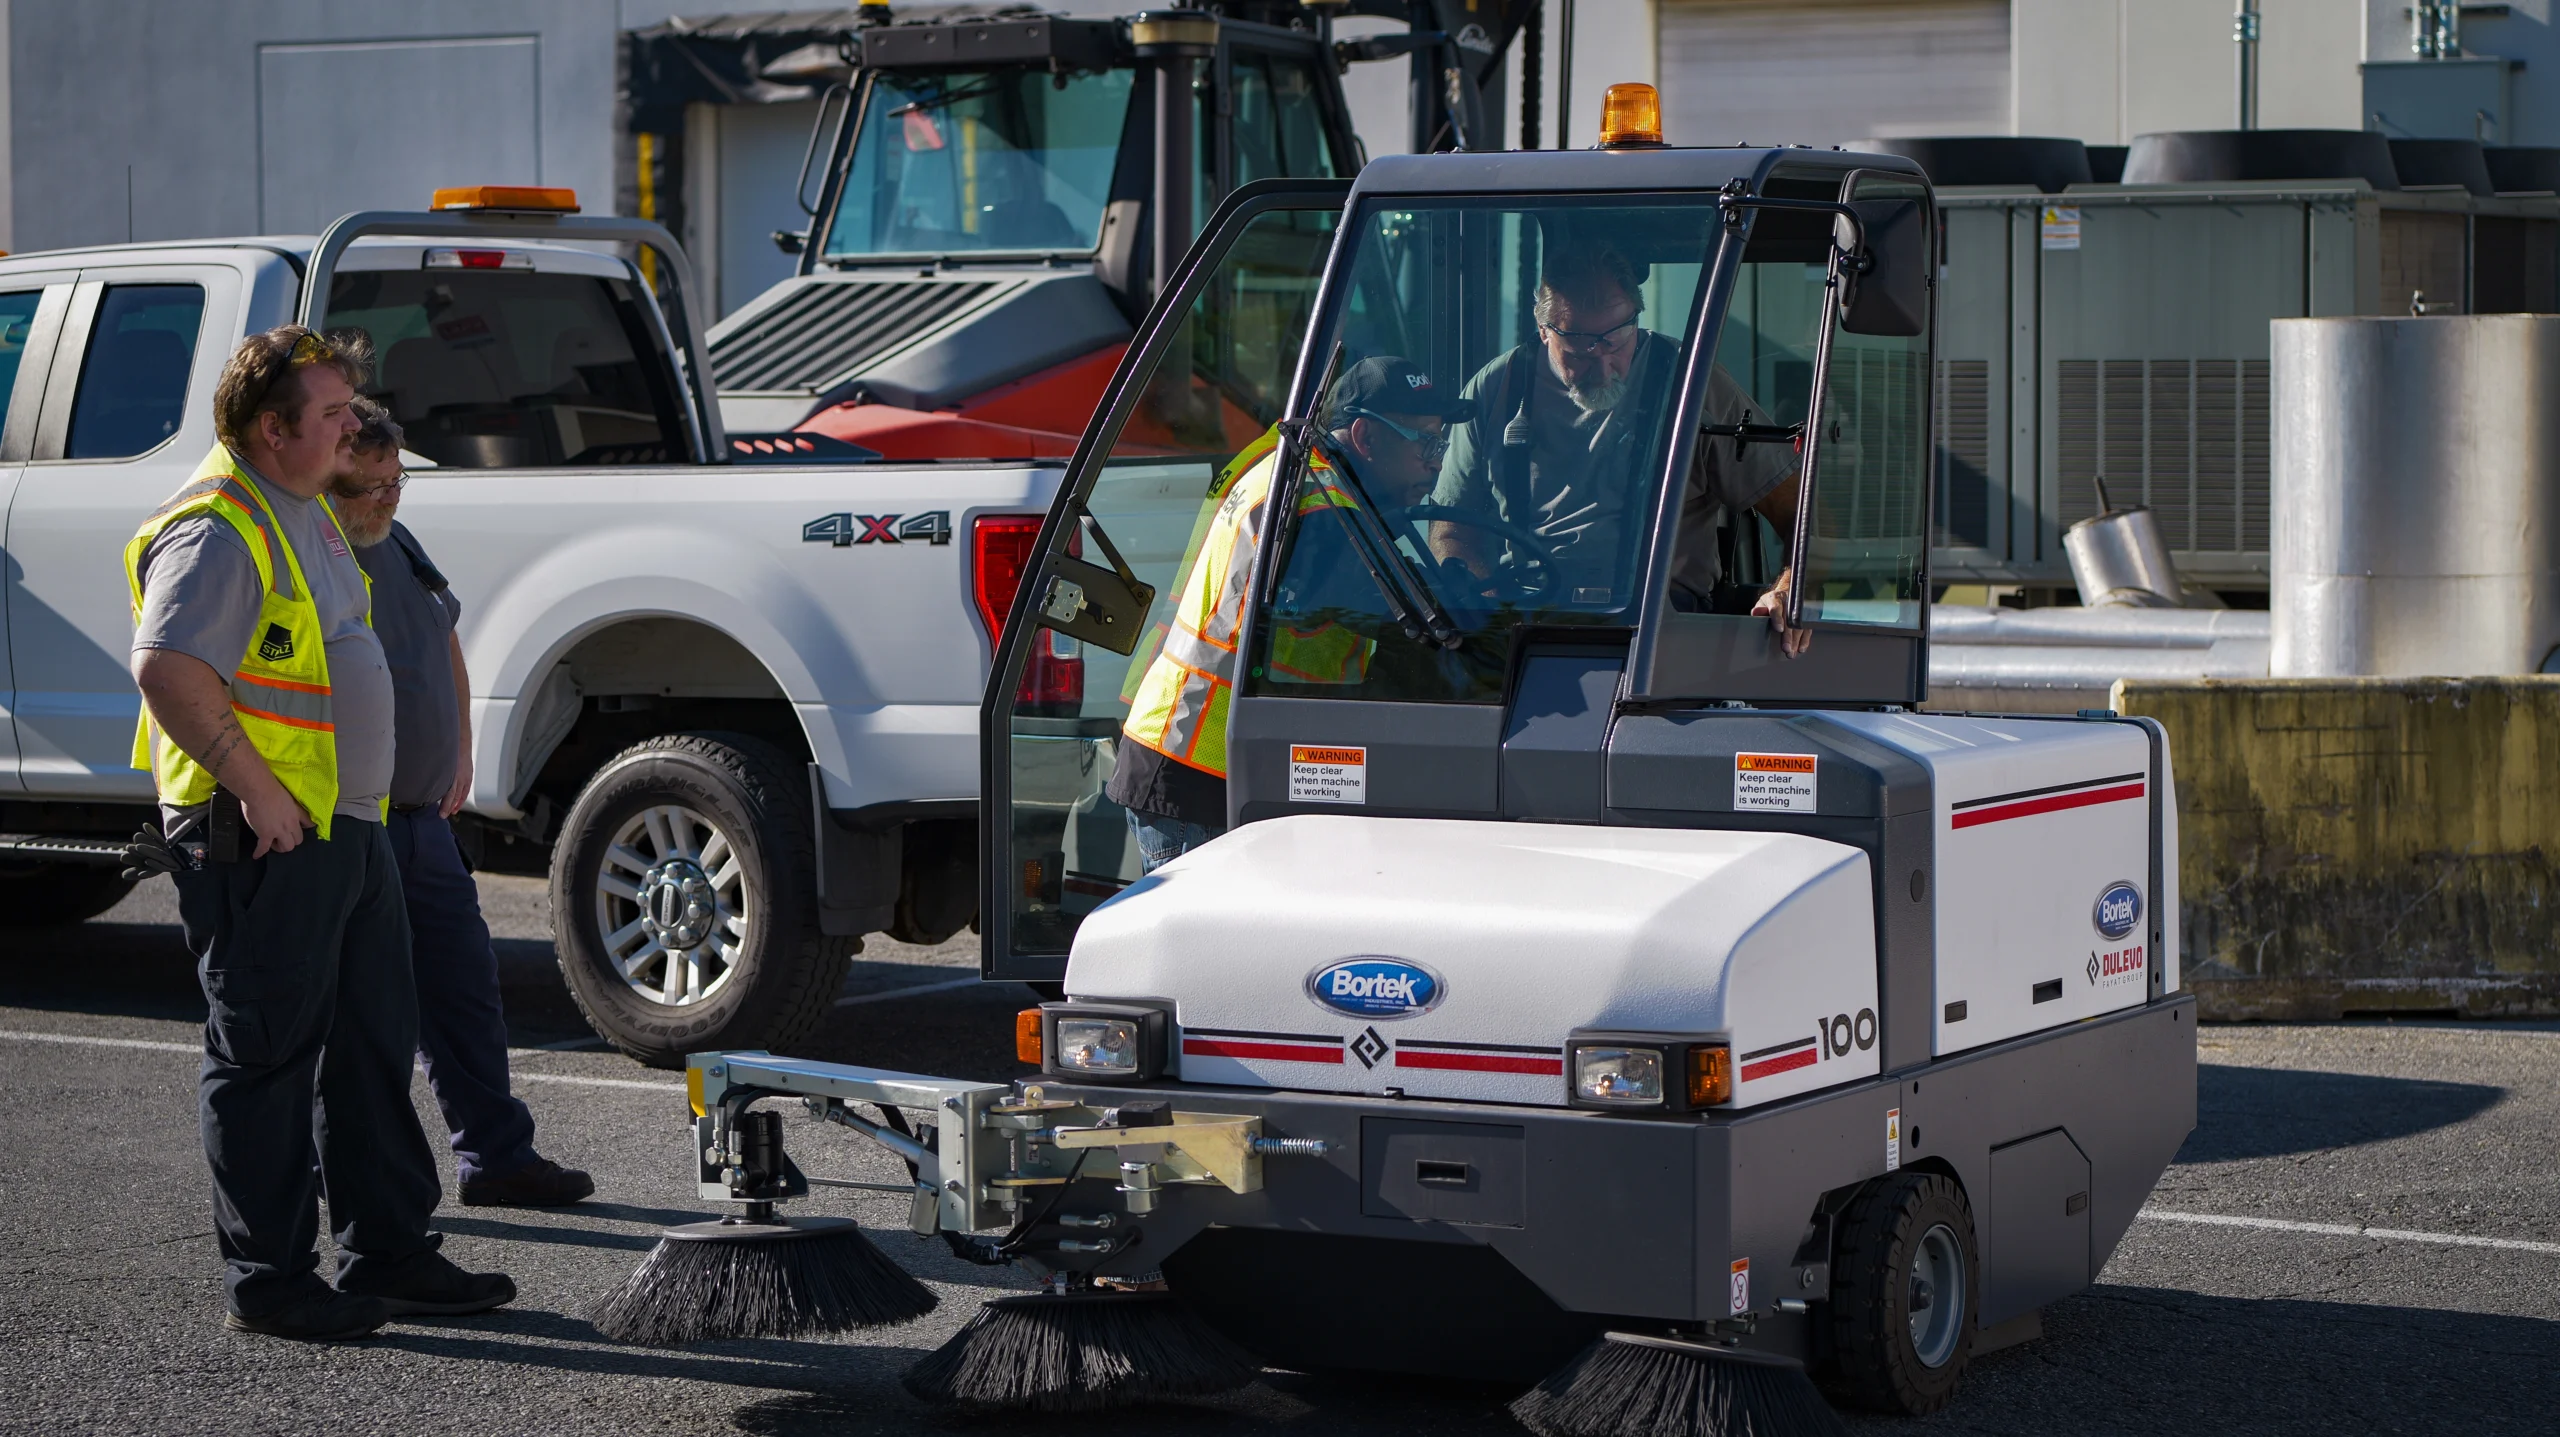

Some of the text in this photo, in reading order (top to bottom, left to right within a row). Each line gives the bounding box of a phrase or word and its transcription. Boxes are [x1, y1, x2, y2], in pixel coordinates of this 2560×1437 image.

[1308, 750, 1361, 762] WARNING
[1294, 764, 1343, 775] Keep clear
[1754, 758, 1812, 770] WARNING
[1294, 776, 1360, 787] when machine
[1739, 773, 1792, 784] Keep clear
[1293, 786, 1341, 799] is working
[1739, 784, 1811, 795] when machine
[1739, 795, 1790, 808] is working
[2102, 895, 2134, 924] Bortek
[2103, 945, 2143, 976] DULEVO
[2102, 971, 2143, 989] FAYAT GROUP
[1331, 969, 1418, 1006] Bortek
[1818, 1007, 1877, 1061] 100
